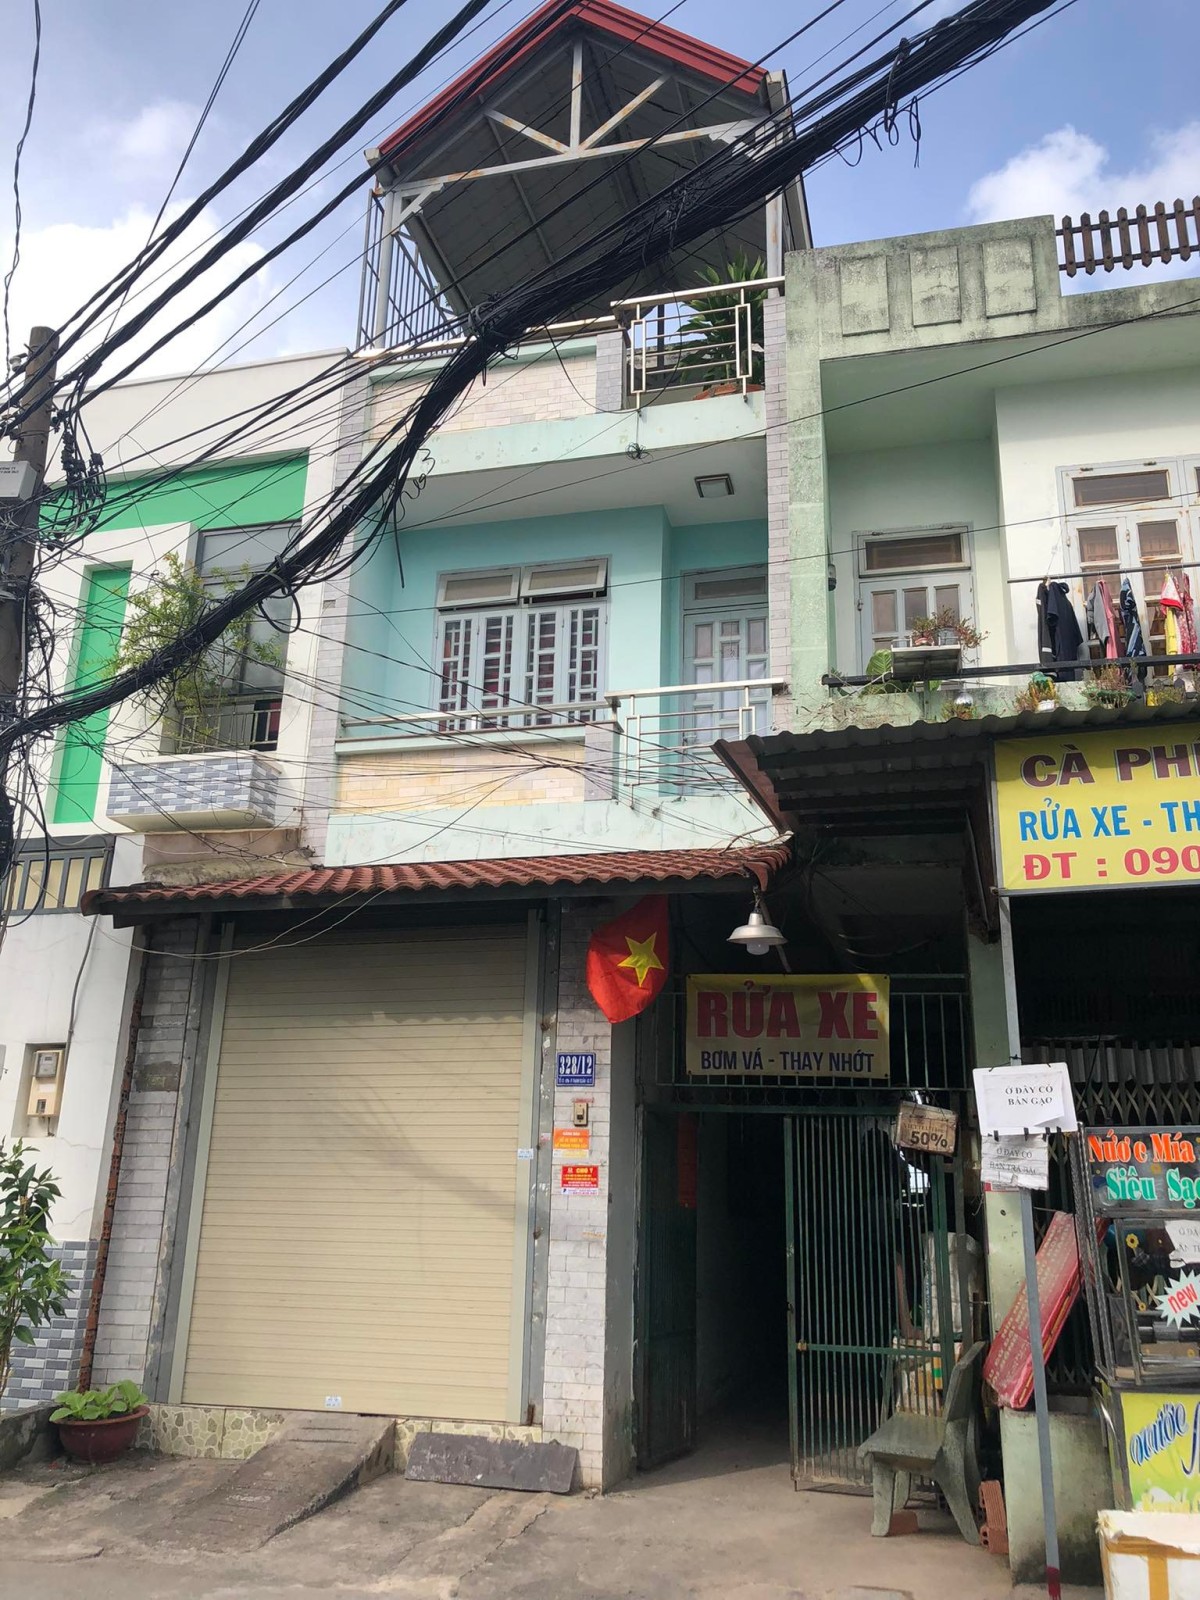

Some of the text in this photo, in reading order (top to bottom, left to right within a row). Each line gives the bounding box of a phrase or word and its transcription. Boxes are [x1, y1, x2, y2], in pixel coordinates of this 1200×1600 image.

[1021, 735, 1200, 787] CÀ PH
[1019, 797, 1082, 841] RỬA
[1090, 805, 1131, 837] XE
[1023, 852, 1077, 880] ĐT
[696, 979, 879, 1039] RỬA XE
[559, 1055, 593, 1075] 328/12
[701, 1050, 737, 1069] BƠM
[742, 1047, 764, 1070] VÁ
[779, 1051, 824, 1070] THAY
[829, 1048, 875, 1072] NHỚT
[910, 1131, 948, 1148] 50%
[1150, 1132, 1196, 1163] Mía
[1106, 1166, 1157, 1200] Siêu
[1168, 1283, 1198, 1314] new
